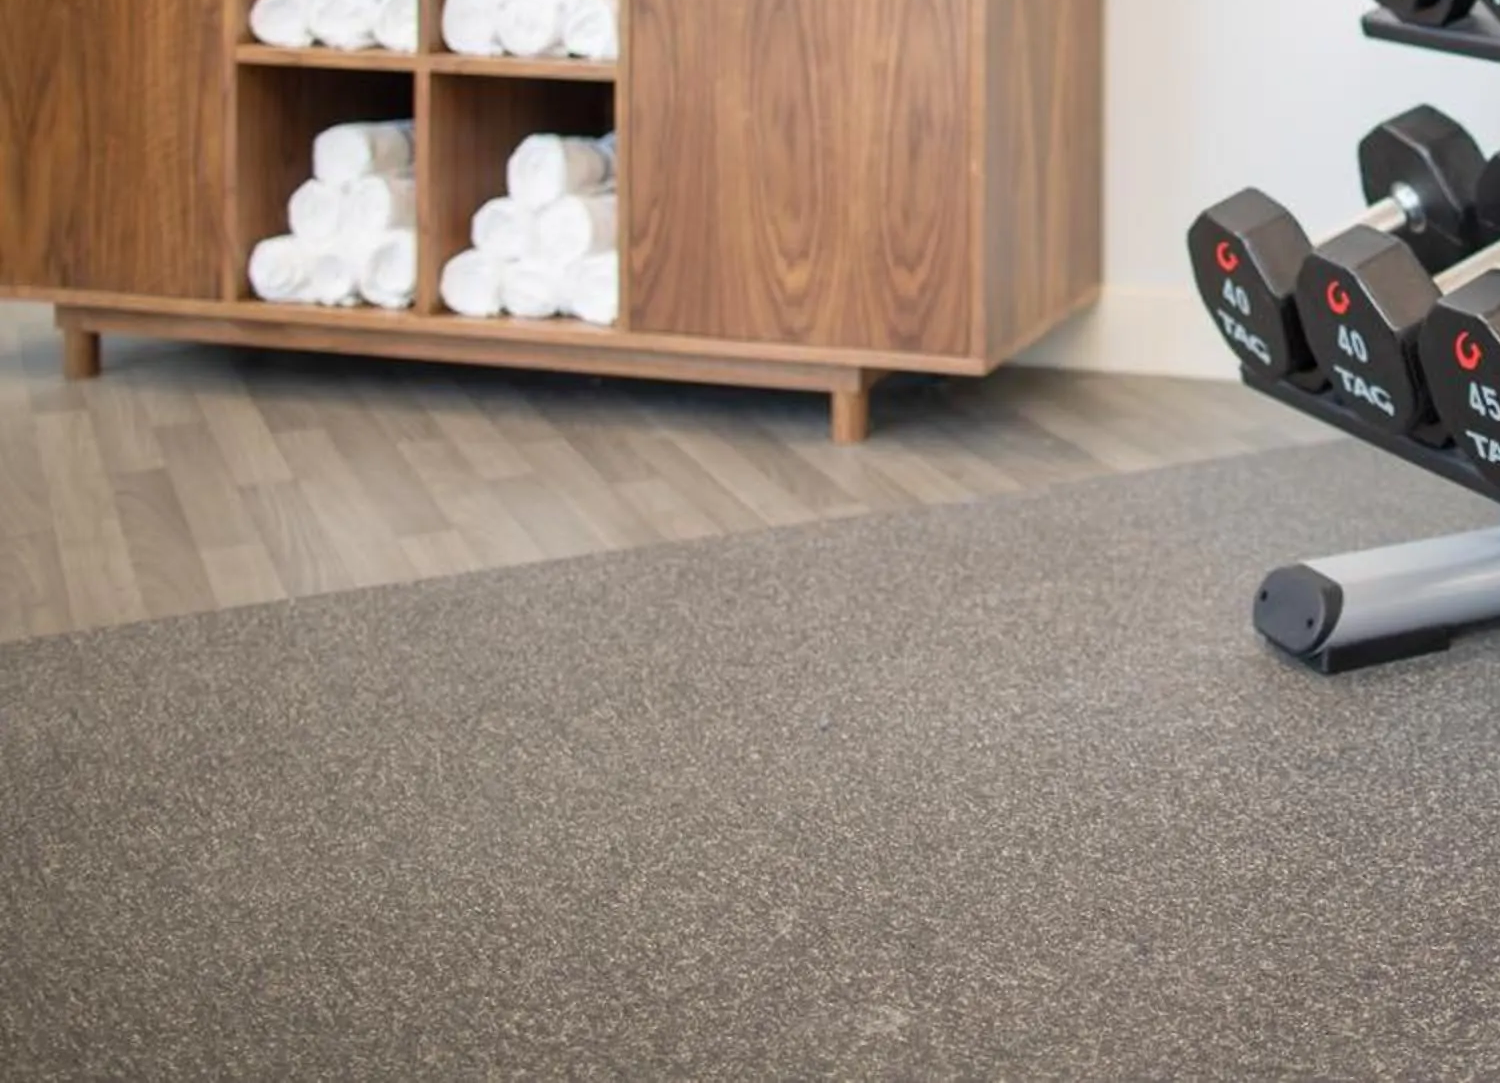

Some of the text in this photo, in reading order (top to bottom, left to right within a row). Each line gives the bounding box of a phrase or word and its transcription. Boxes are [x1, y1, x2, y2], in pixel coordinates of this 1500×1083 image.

[1221, 278, 1249, 315] 40
[1219, 308, 1271, 366] TAG
[1337, 324, 1368, 363] 40
[1333, 365, 1395, 417] TAG
